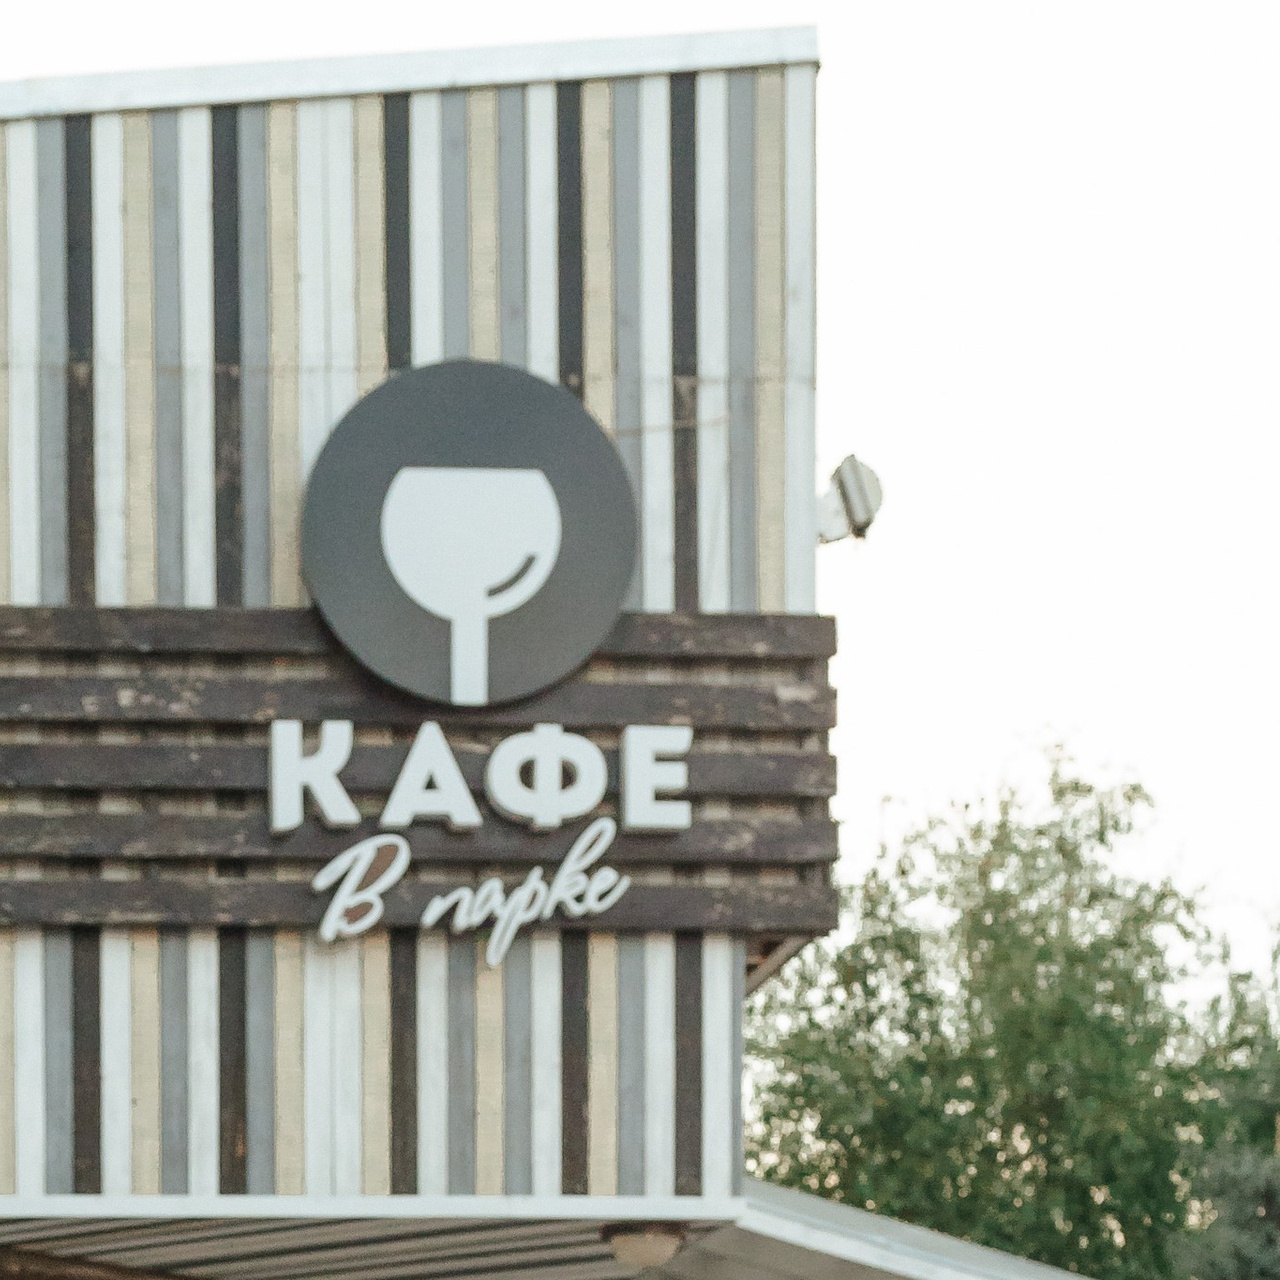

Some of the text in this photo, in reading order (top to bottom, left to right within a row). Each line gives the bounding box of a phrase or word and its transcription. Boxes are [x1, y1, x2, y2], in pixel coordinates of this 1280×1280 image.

[269, 719, 694, 832] КАФЕ
[312, 817, 631, 967] В парке
